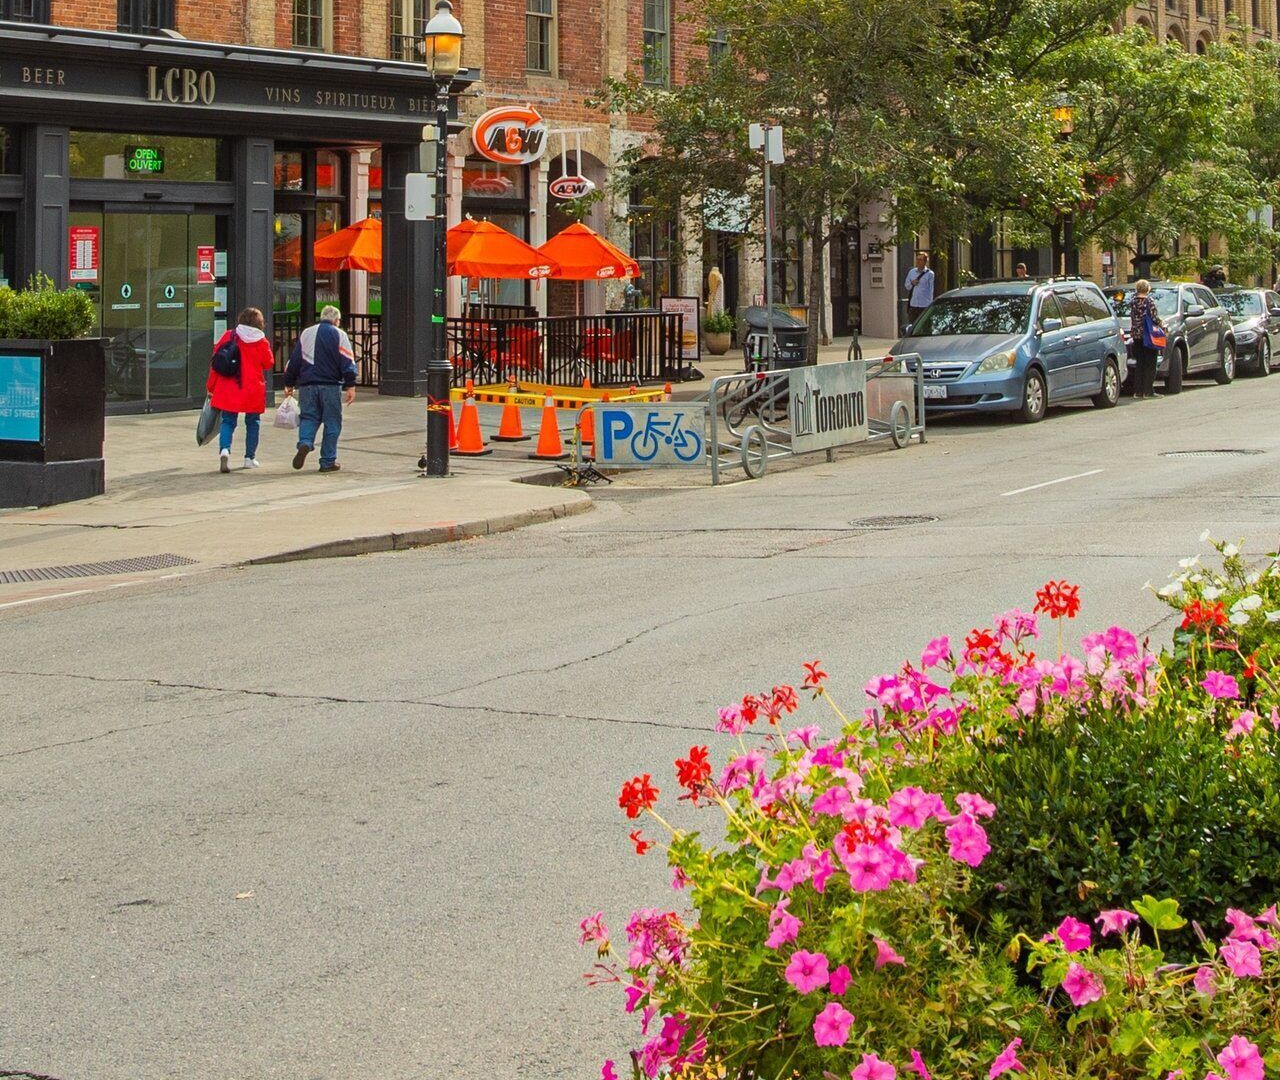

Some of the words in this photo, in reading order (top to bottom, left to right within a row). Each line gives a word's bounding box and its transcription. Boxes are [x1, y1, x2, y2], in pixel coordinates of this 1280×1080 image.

[21, 66, 66, 86] BEER
[146, 65, 217, 105] LCBO
[265, 86, 302, 103] VINS
[314, 90, 397, 111] SPIRITUEUX
[408, 96, 439, 113] BIÈR
[487, 126, 545, 155] A&W
[135, 148, 158, 159] OPEN
[129, 159, 163, 170] OUVERT
[556, 184, 586, 194] A&W
[514, 397, 536, 405] CAUTION
[812, 388, 865, 433] TORONTO
[14, 409, 38, 418] STREET
[601, 410, 634, 460] P
